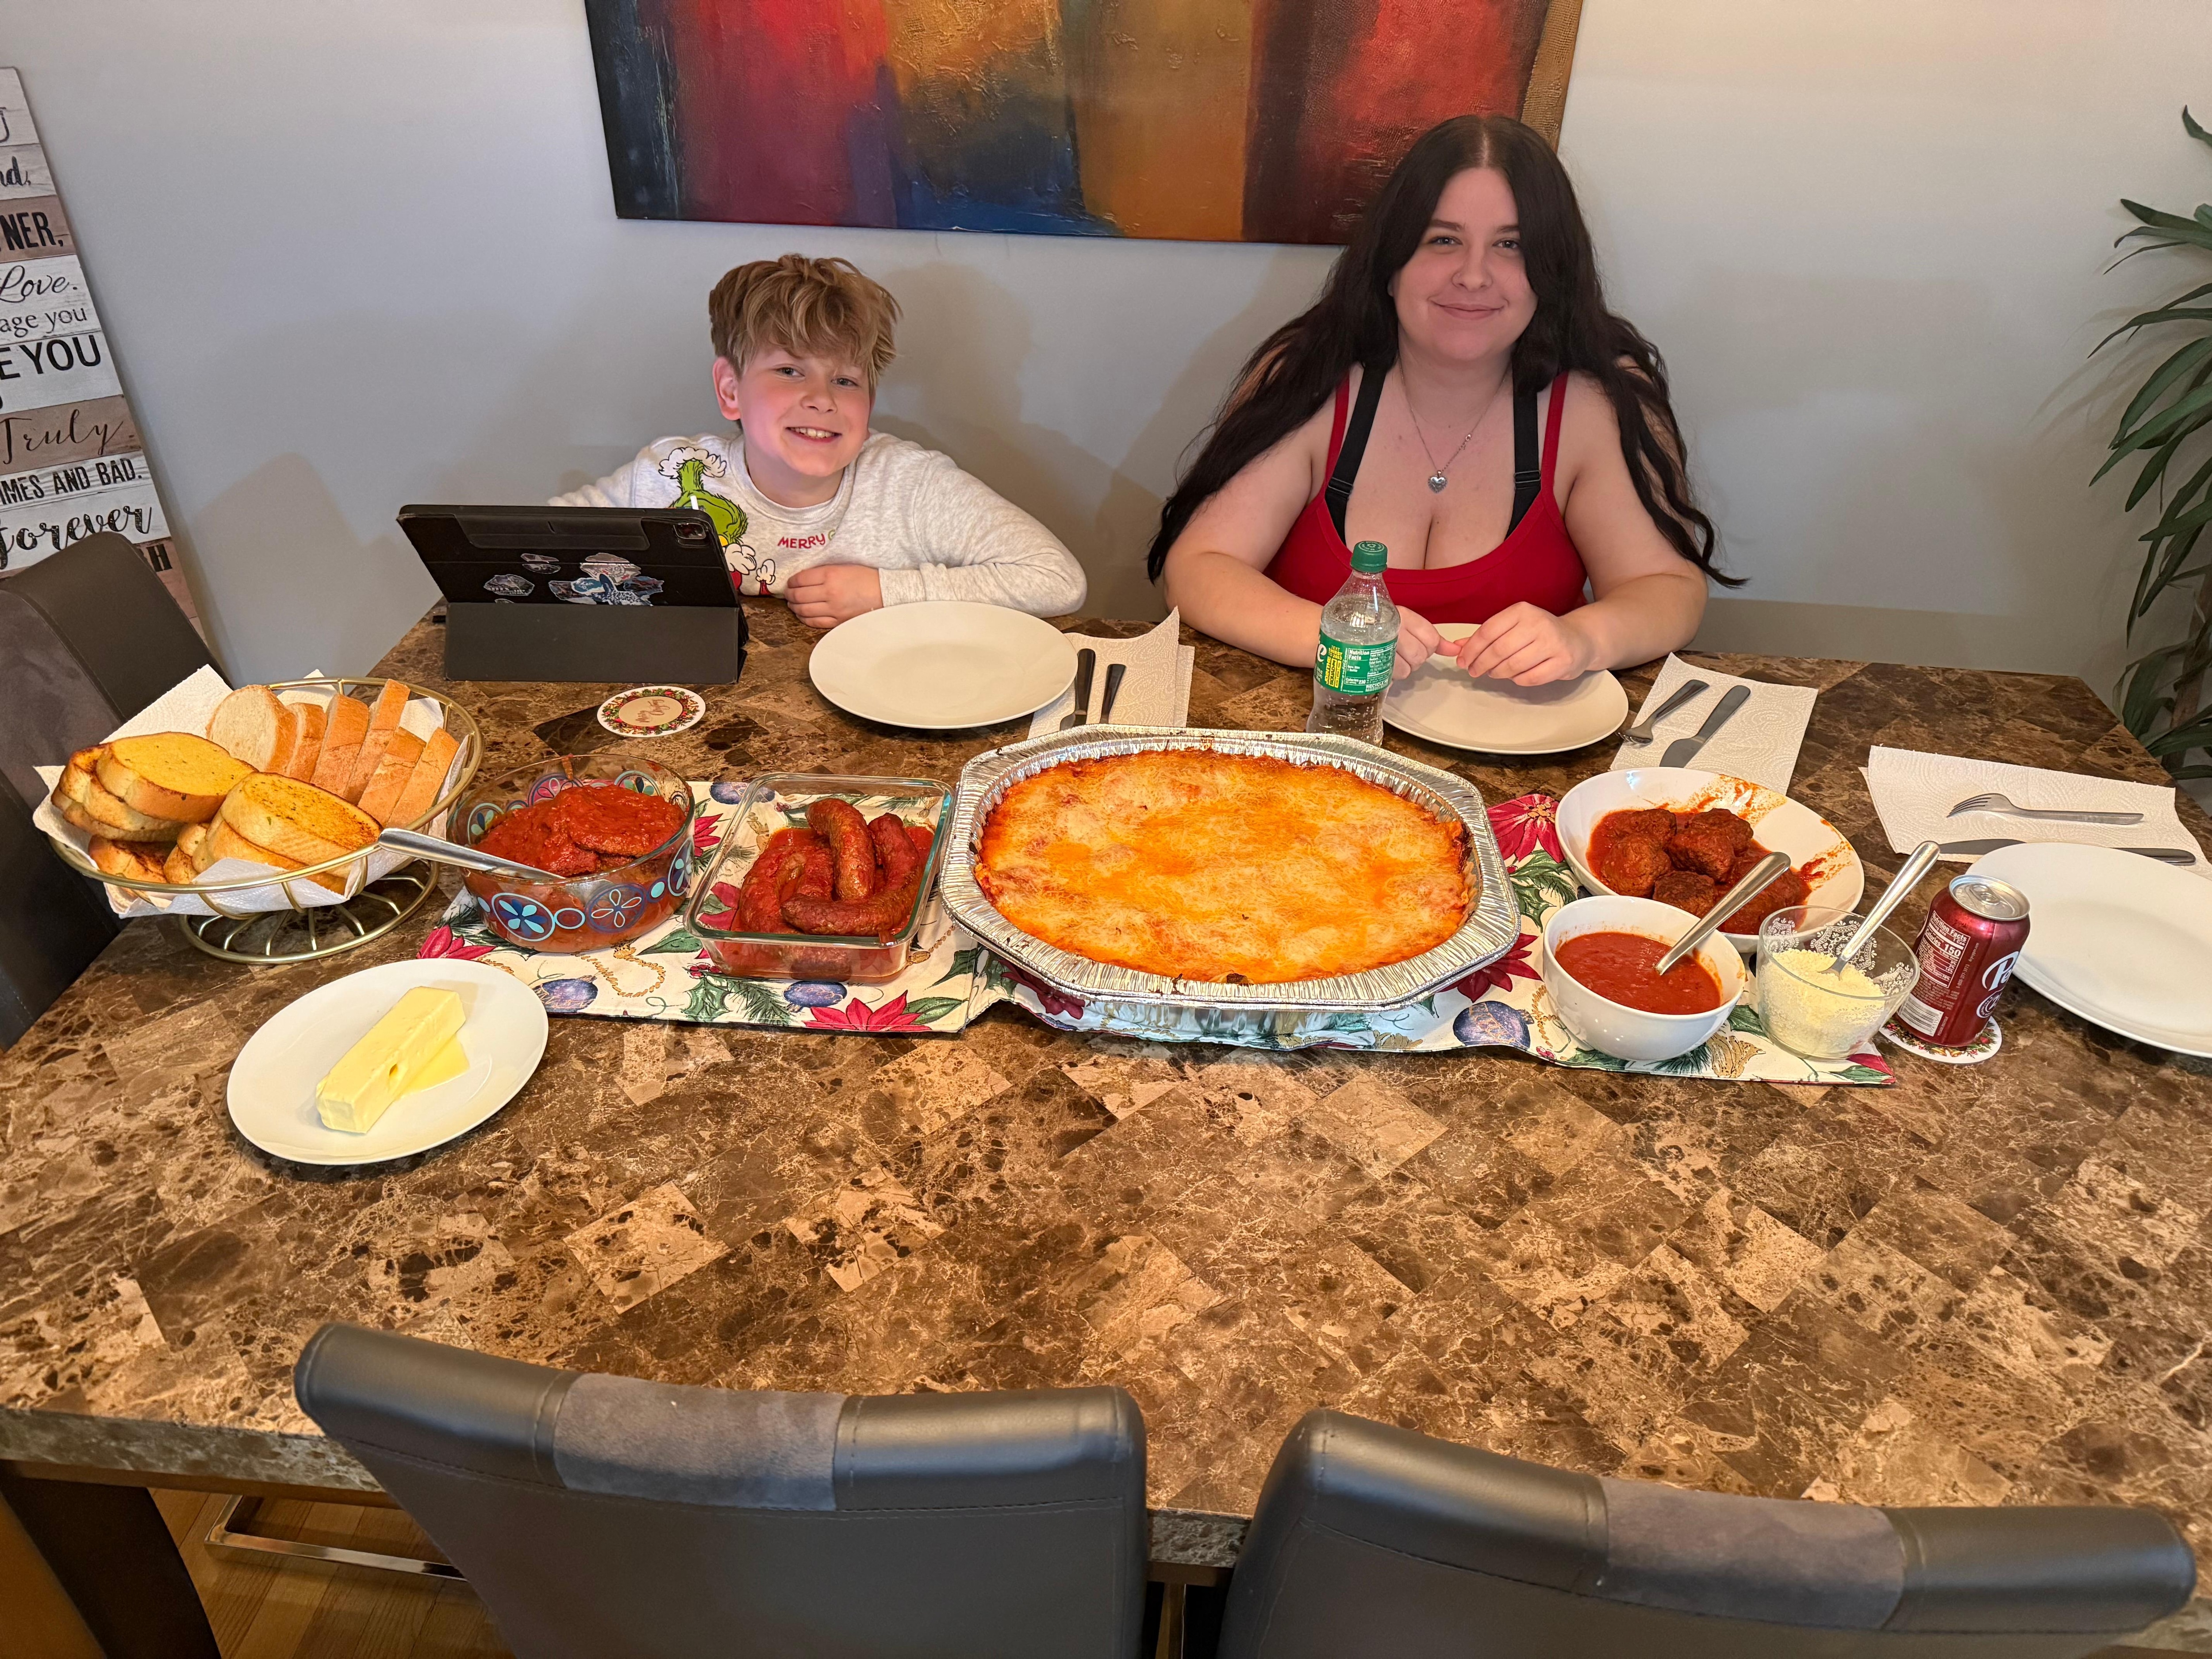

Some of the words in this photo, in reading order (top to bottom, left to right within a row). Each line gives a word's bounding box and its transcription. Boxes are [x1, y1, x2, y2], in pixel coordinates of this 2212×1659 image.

[0, 265, 77, 303] Love.
[0, 315, 39, 338] age
[44, 308, 87, 334] you
[19, 335, 101, 374] YOU
[0, 409, 123, 465] Truly
[52, 466, 90, 495] AND
[96, 458, 142, 486] BAD.
[777, 534, 826, 549] MERRY
[1926, 929, 1941, 947] Calories
[1944, 943, 1961, 957] 150
[1932, 912, 1950, 933] Nutrition
[1950, 929, 1967, 941] Facts
